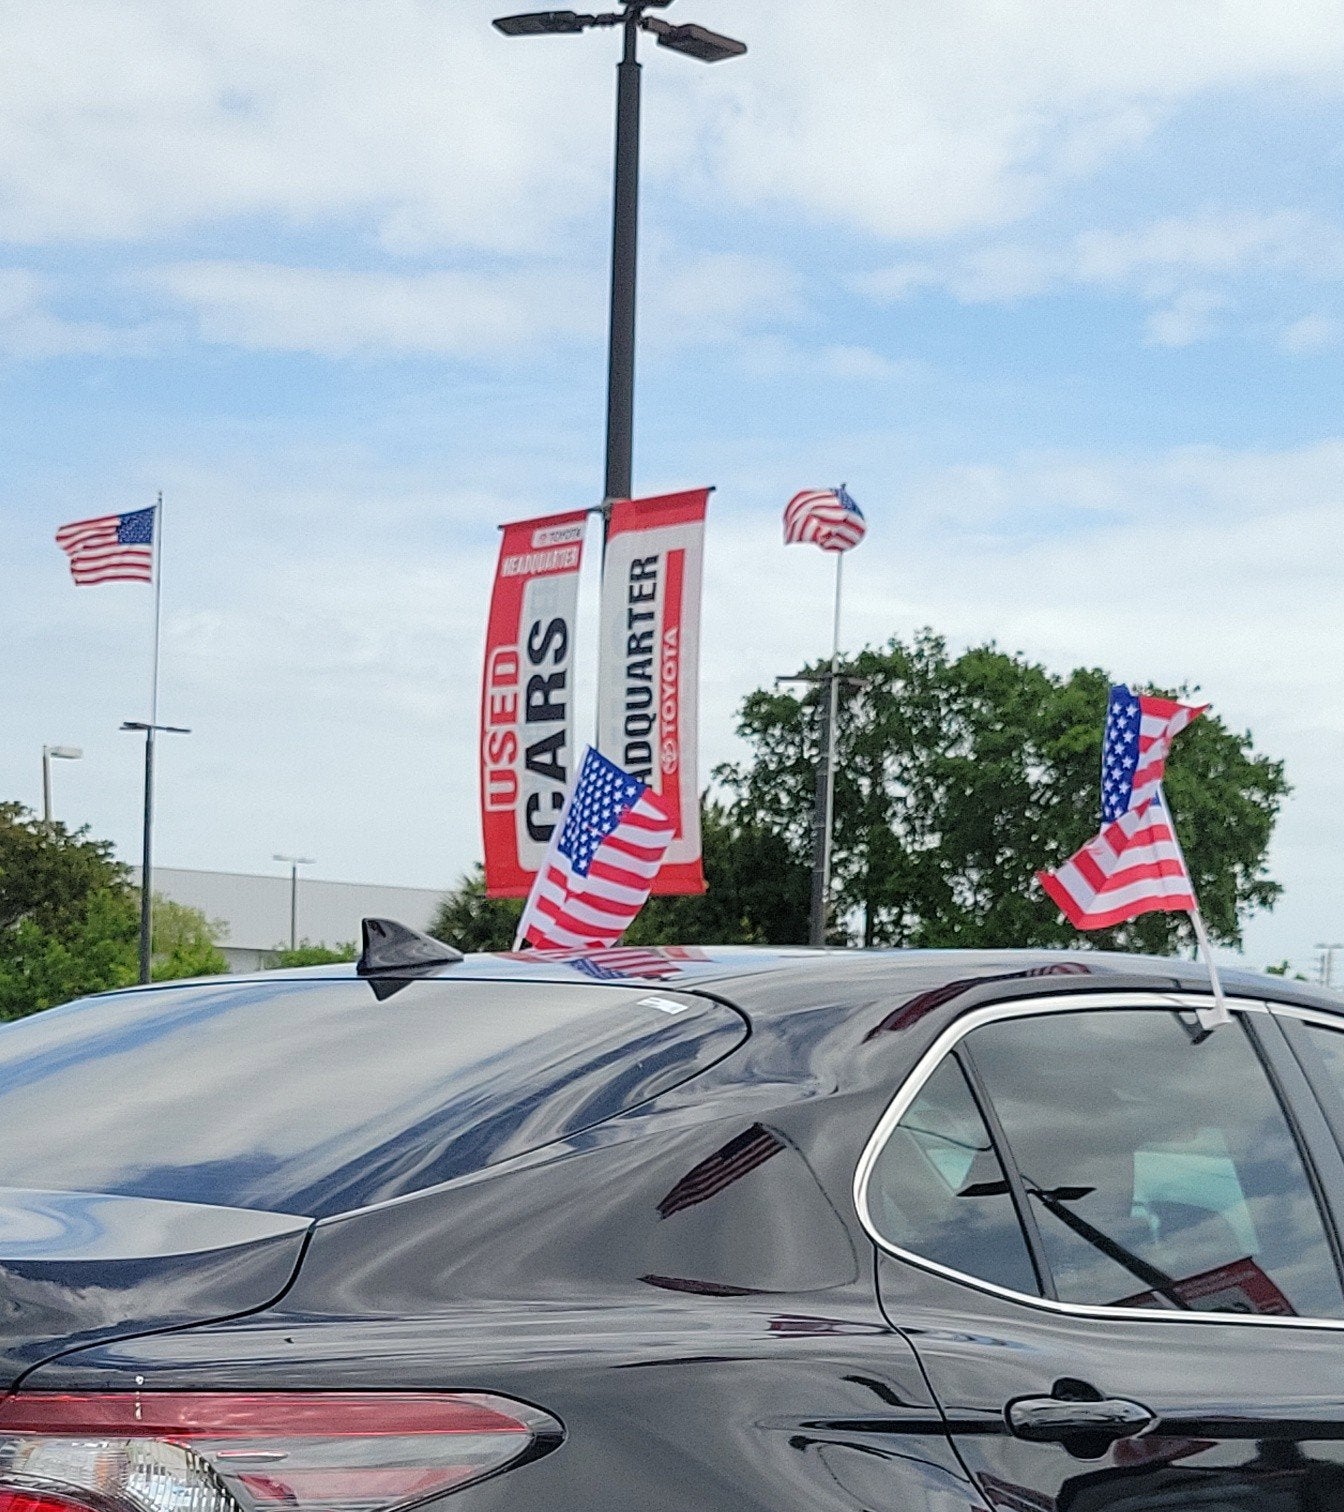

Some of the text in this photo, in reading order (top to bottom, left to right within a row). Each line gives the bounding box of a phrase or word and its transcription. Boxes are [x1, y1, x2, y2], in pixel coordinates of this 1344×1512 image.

[487, 649, 519, 807] USED
[525, 617, 568, 842] CARS
[624, 554, 659, 789] ADQUARTER
[661, 627, 679, 735] TOYOTA
